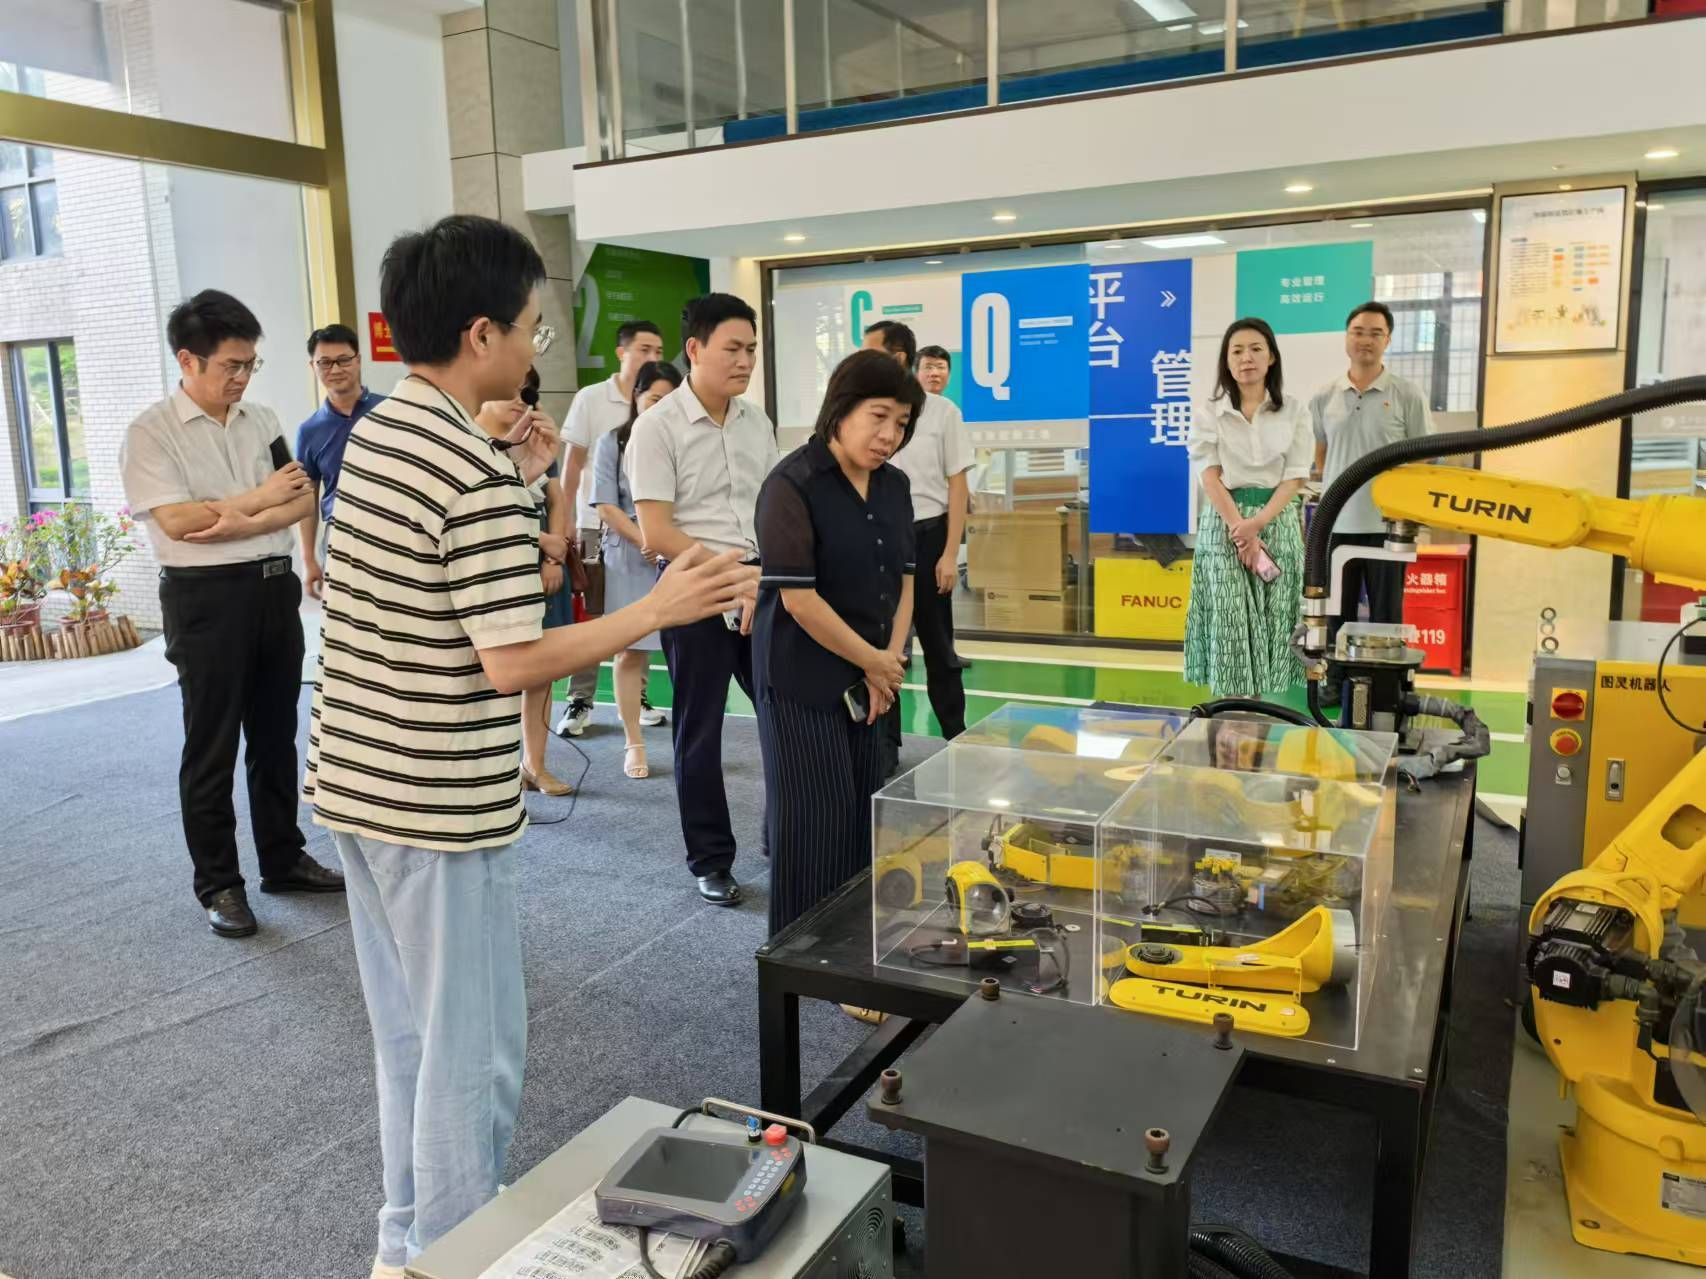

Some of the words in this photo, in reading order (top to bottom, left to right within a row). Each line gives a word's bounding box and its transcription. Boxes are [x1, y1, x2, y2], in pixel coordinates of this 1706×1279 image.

[573, 272, 605, 369] 2
[971, 292, 1011, 400] Q
[1089, 272, 1125, 368] 平台
[1150, 350, 1191, 446] 管理
[1428, 491, 1532, 524] TURIN
[1121, 595, 1183, 609] FANUC
[1600, 675, 1671, 692] 图灵机器人
[1152, 984, 1267, 1012] TURIN
